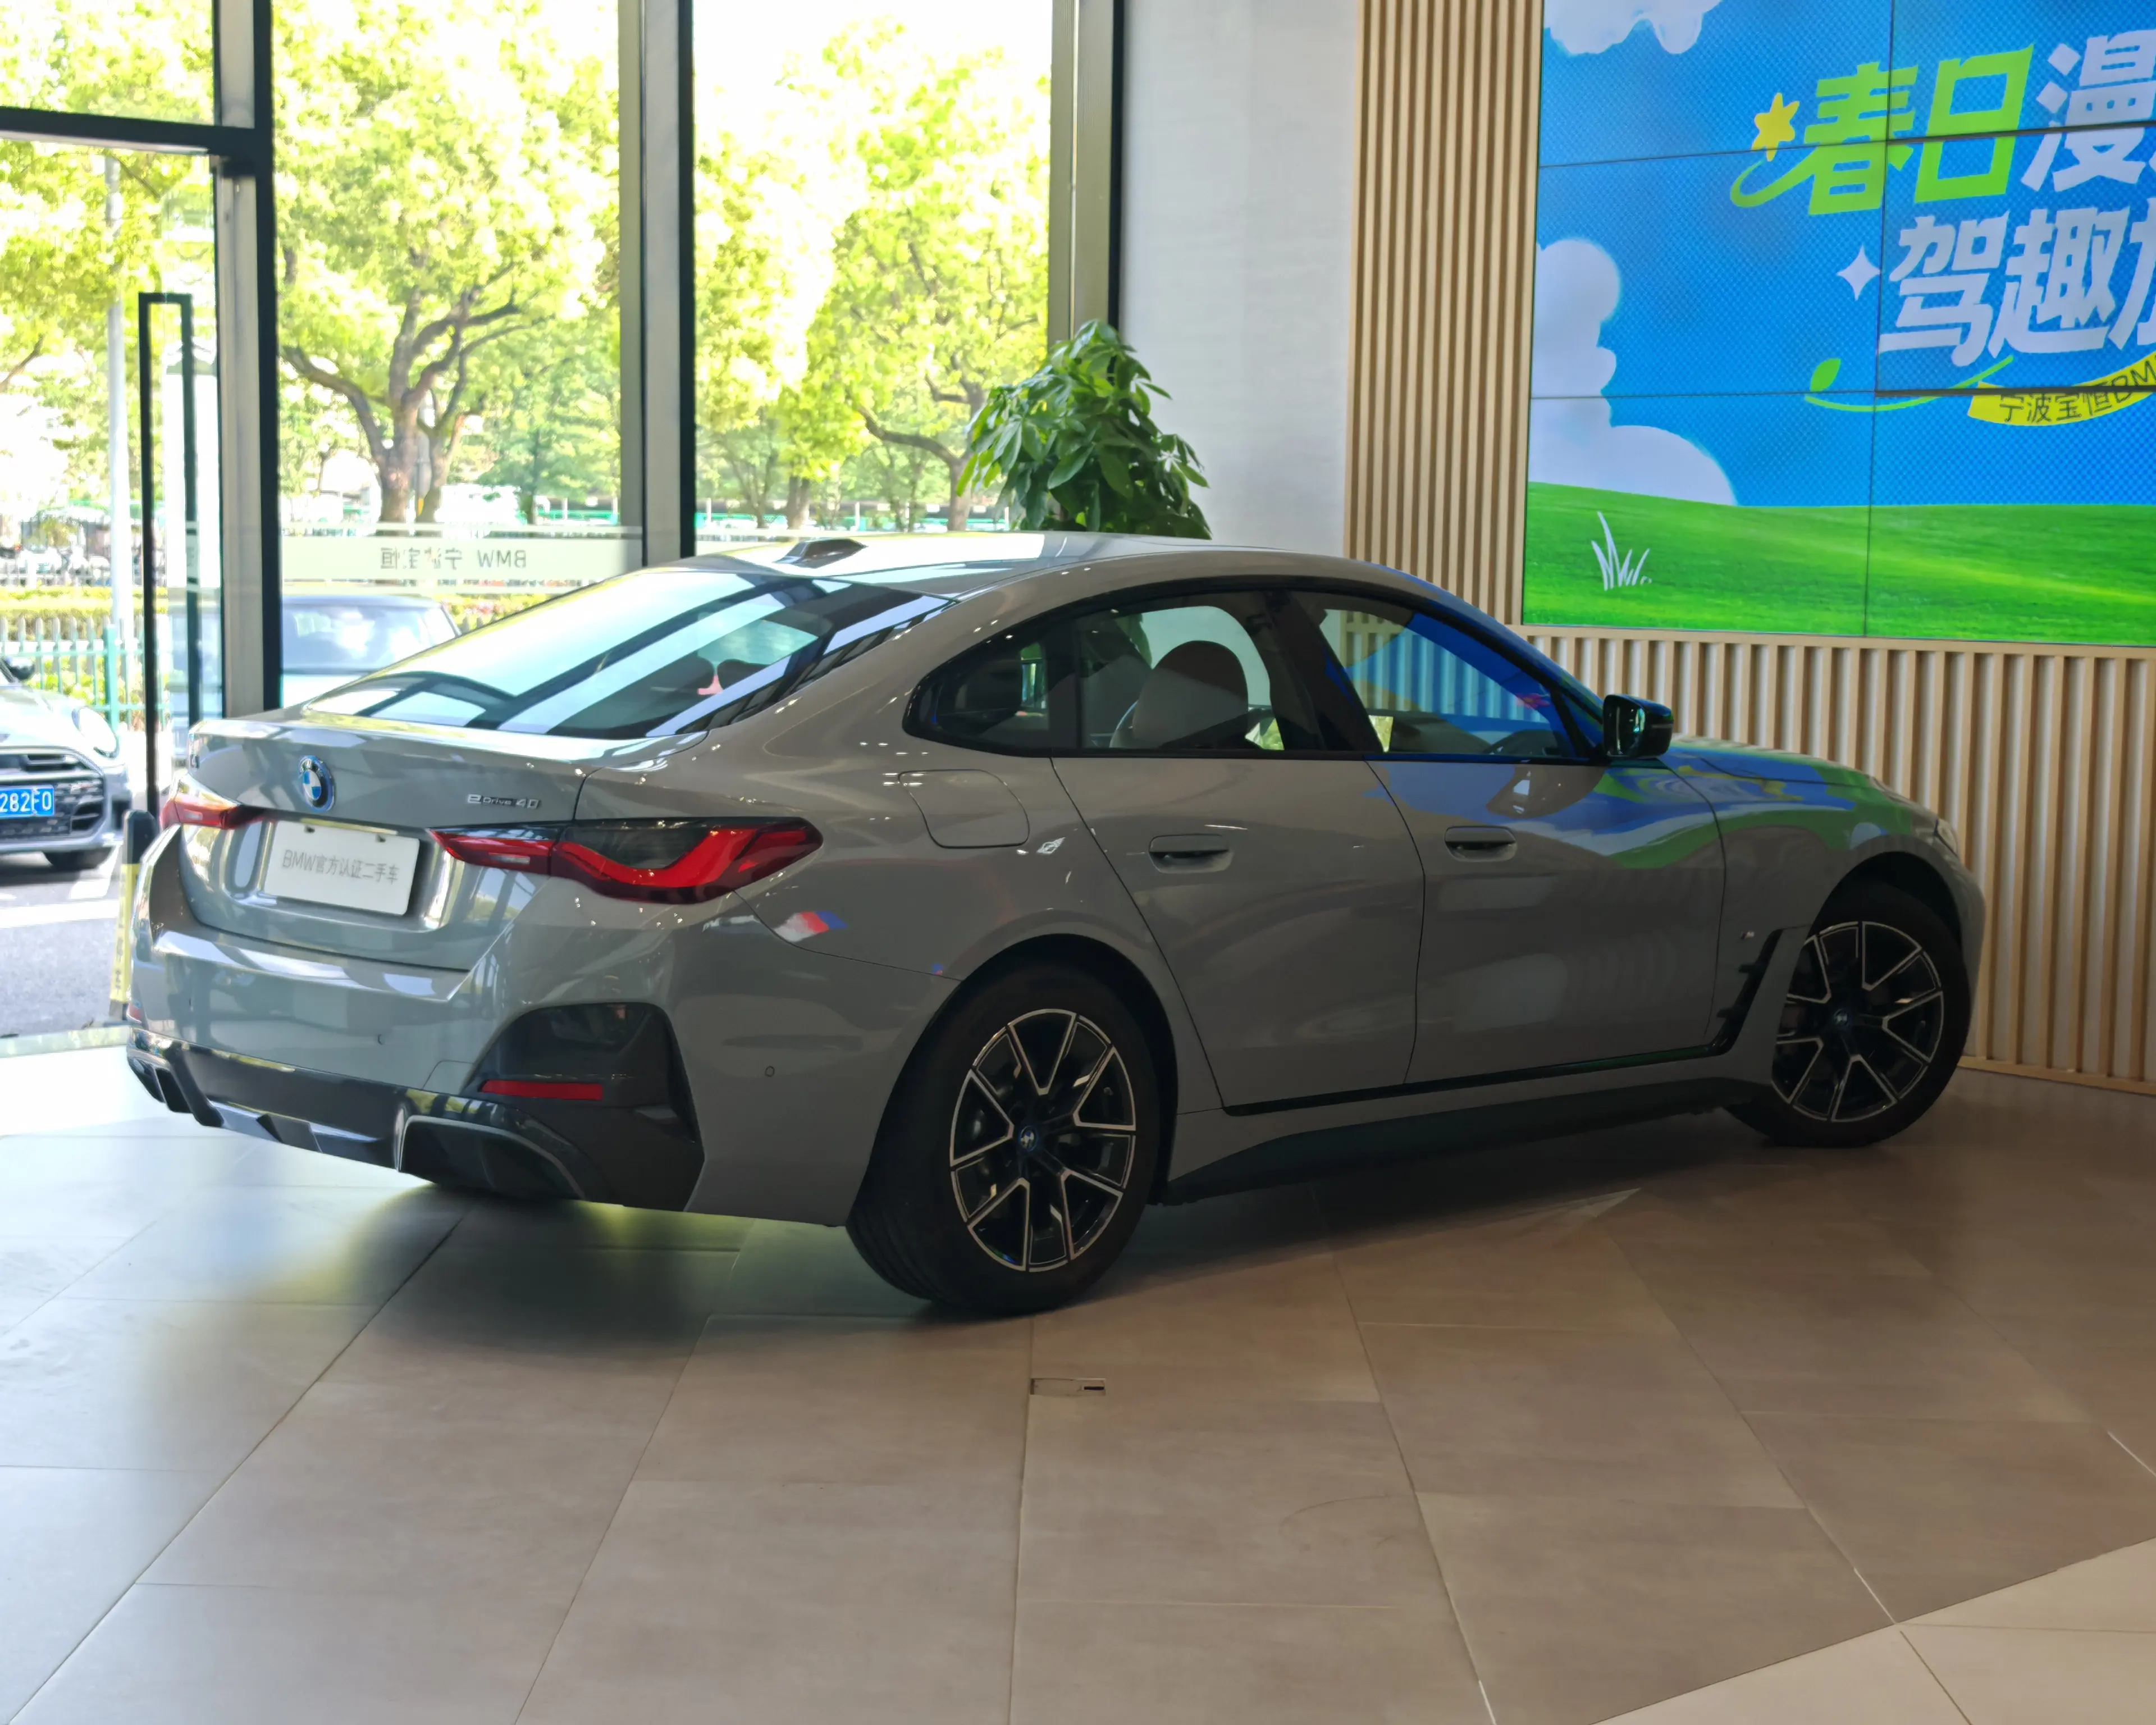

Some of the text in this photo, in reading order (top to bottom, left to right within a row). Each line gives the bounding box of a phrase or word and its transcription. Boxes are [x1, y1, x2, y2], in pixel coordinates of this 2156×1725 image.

[1731, 29, 2156, 215] 春日漫
[1999, 354, 2156, 422] 宁波宝恒BM
[282, 844, 400, 884] BMW官方认证二手车
